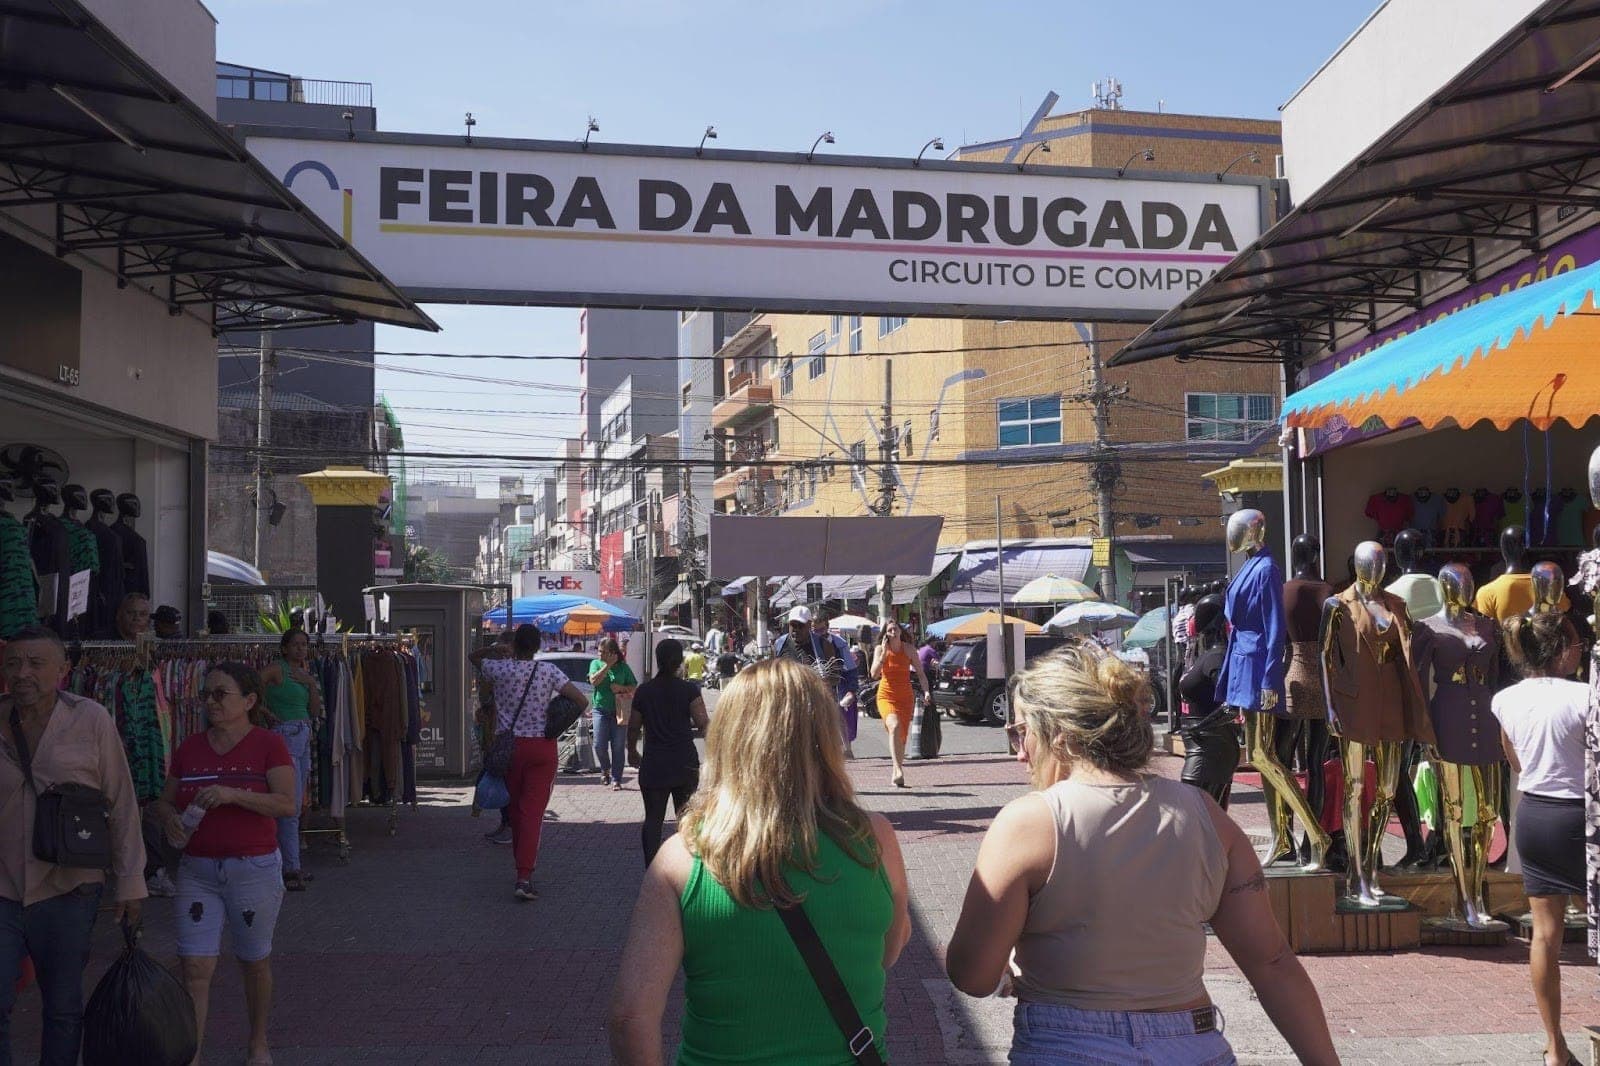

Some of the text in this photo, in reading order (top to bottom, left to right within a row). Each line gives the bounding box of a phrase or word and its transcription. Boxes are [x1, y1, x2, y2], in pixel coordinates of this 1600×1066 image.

[379, 166, 1238, 252] FEIRA DA MADRUGADA
[888, 259, 1217, 291] CIRCUITO DE COMPR
[59, 364, 79, 386] LT-65
[538, 576, 583, 590] FedEx
